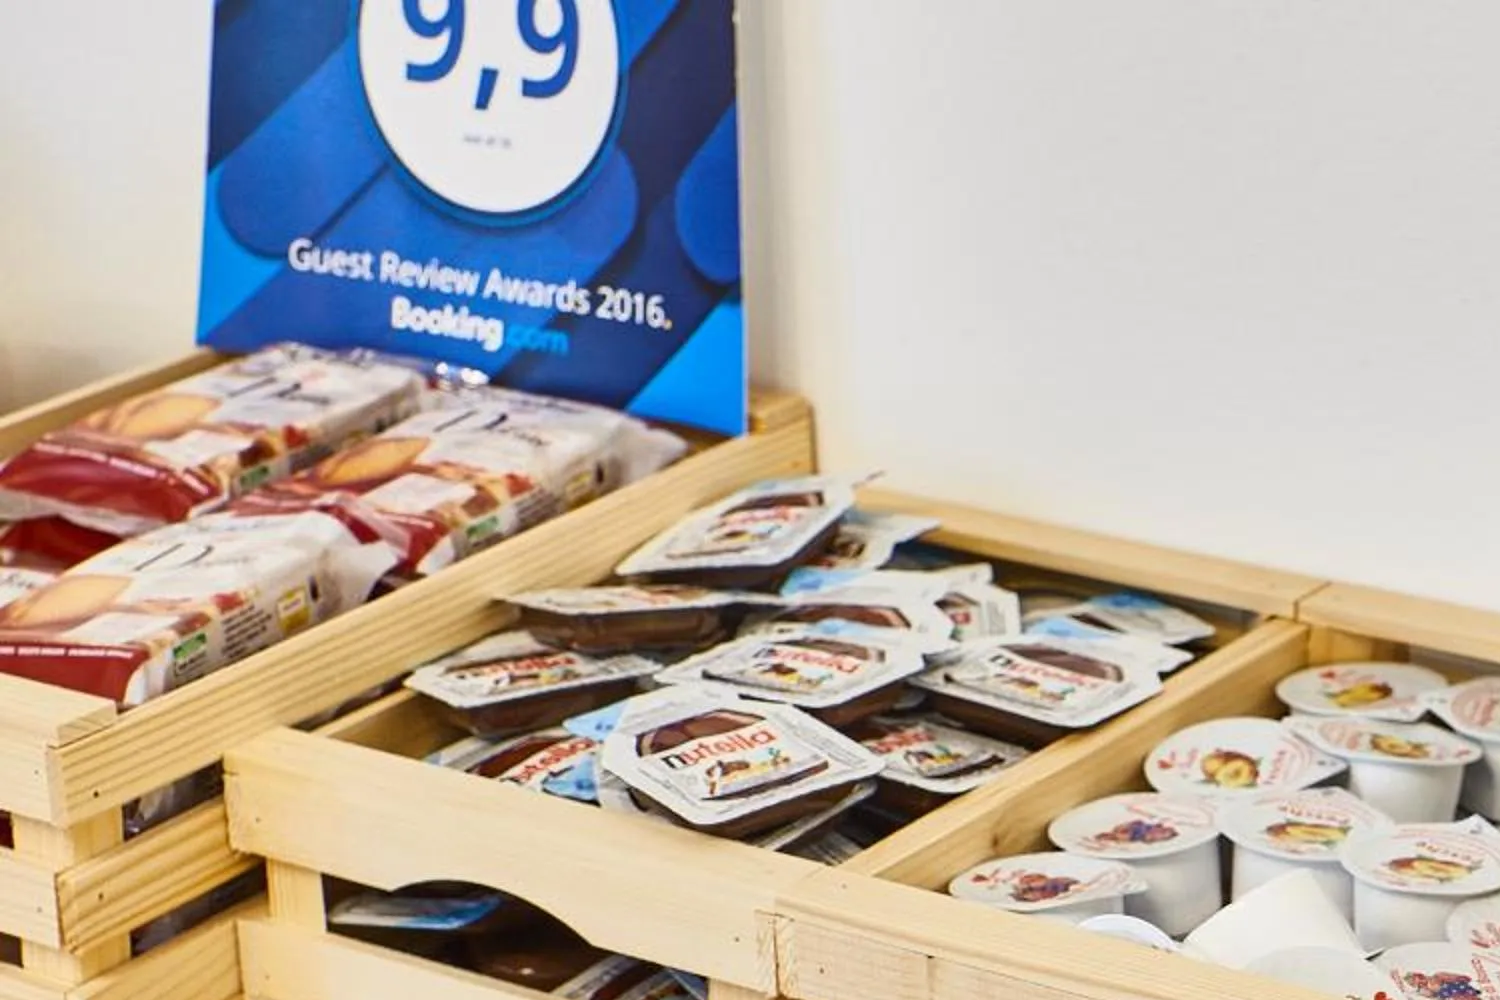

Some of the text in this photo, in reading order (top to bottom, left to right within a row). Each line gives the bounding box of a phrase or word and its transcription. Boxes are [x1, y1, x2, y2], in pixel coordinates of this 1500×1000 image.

[402, 0, 580, 111] 9,9
[288, 237, 375, 281] Guest
[379, 250, 481, 297] Review
[482, 267, 592, 316] Awards
[659, 728, 778, 771] nutella
